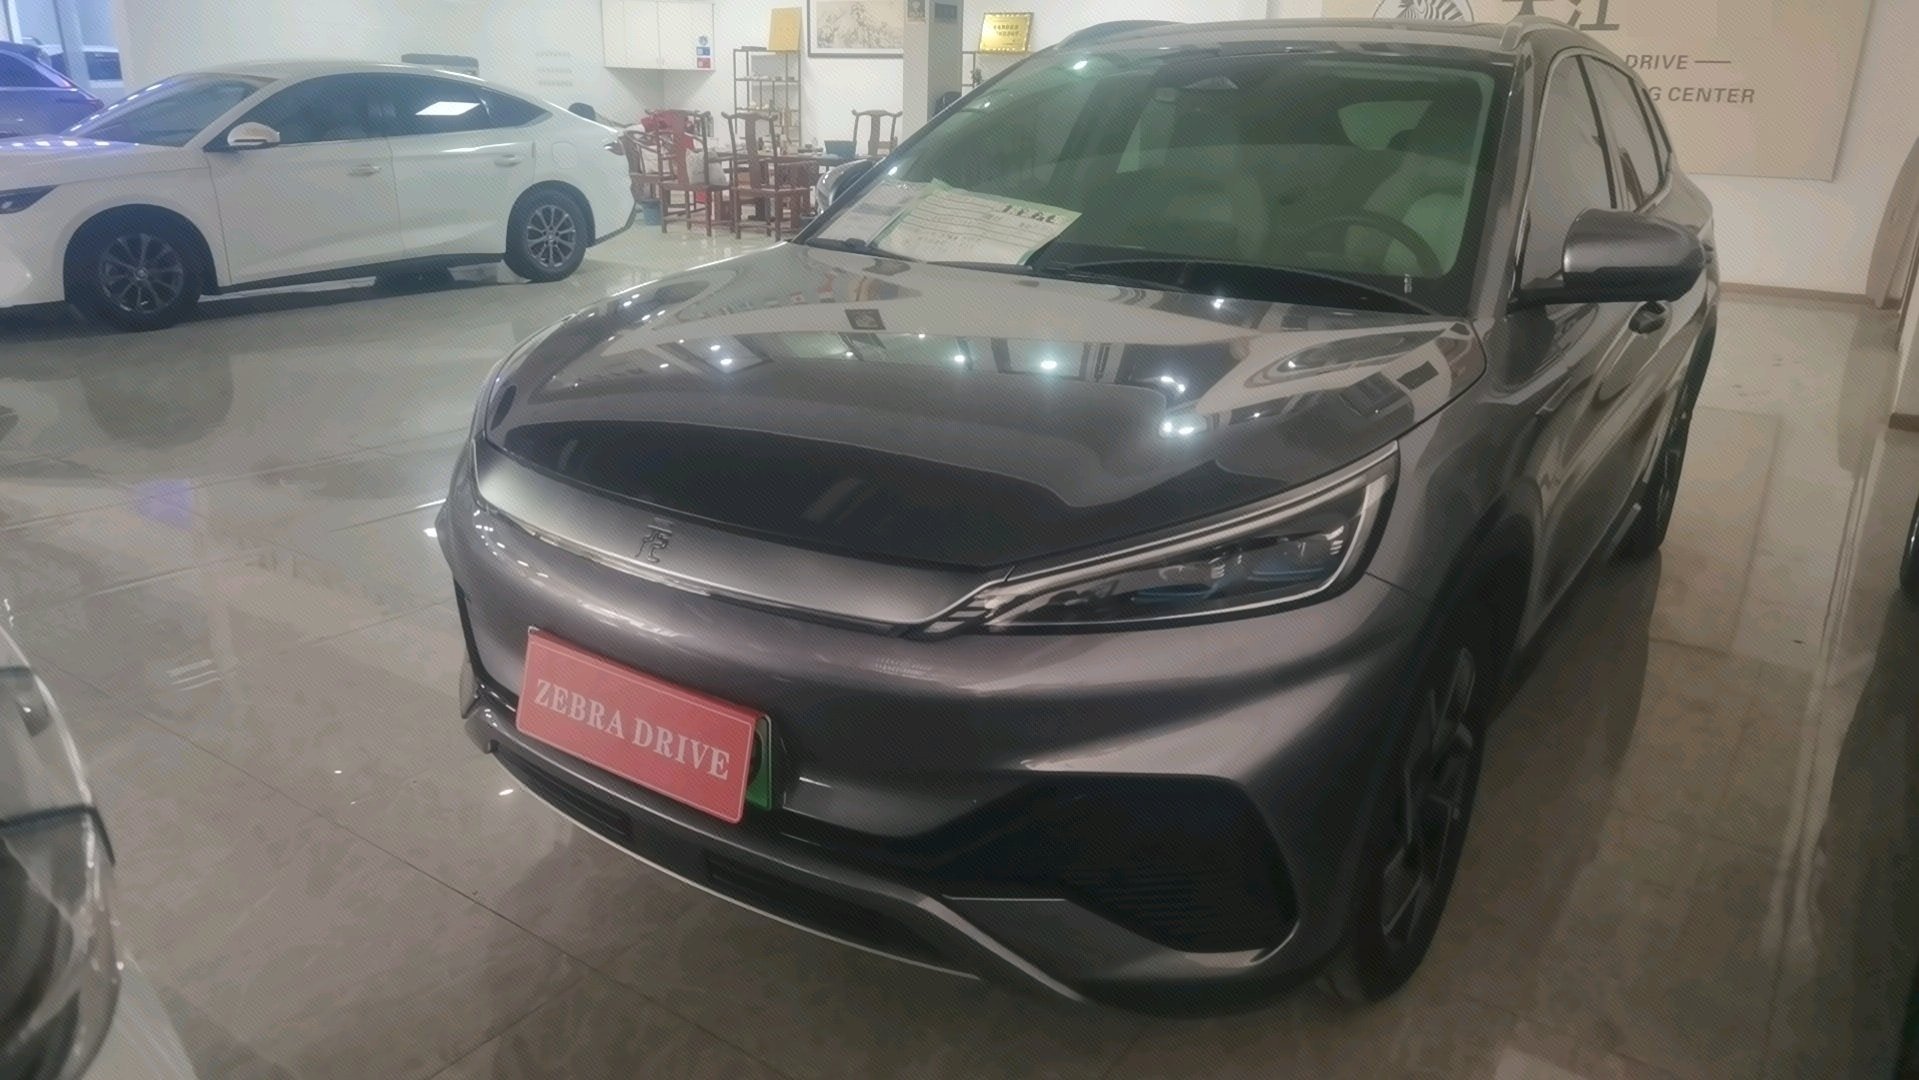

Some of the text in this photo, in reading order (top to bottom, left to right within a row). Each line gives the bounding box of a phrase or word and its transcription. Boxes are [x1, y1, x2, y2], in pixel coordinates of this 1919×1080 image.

[1626, 54, 1689, 70] DRIVE
[1668, 86, 1755, 104] CENTER
[534, 679, 731, 781] ZEBRA DRIVE
